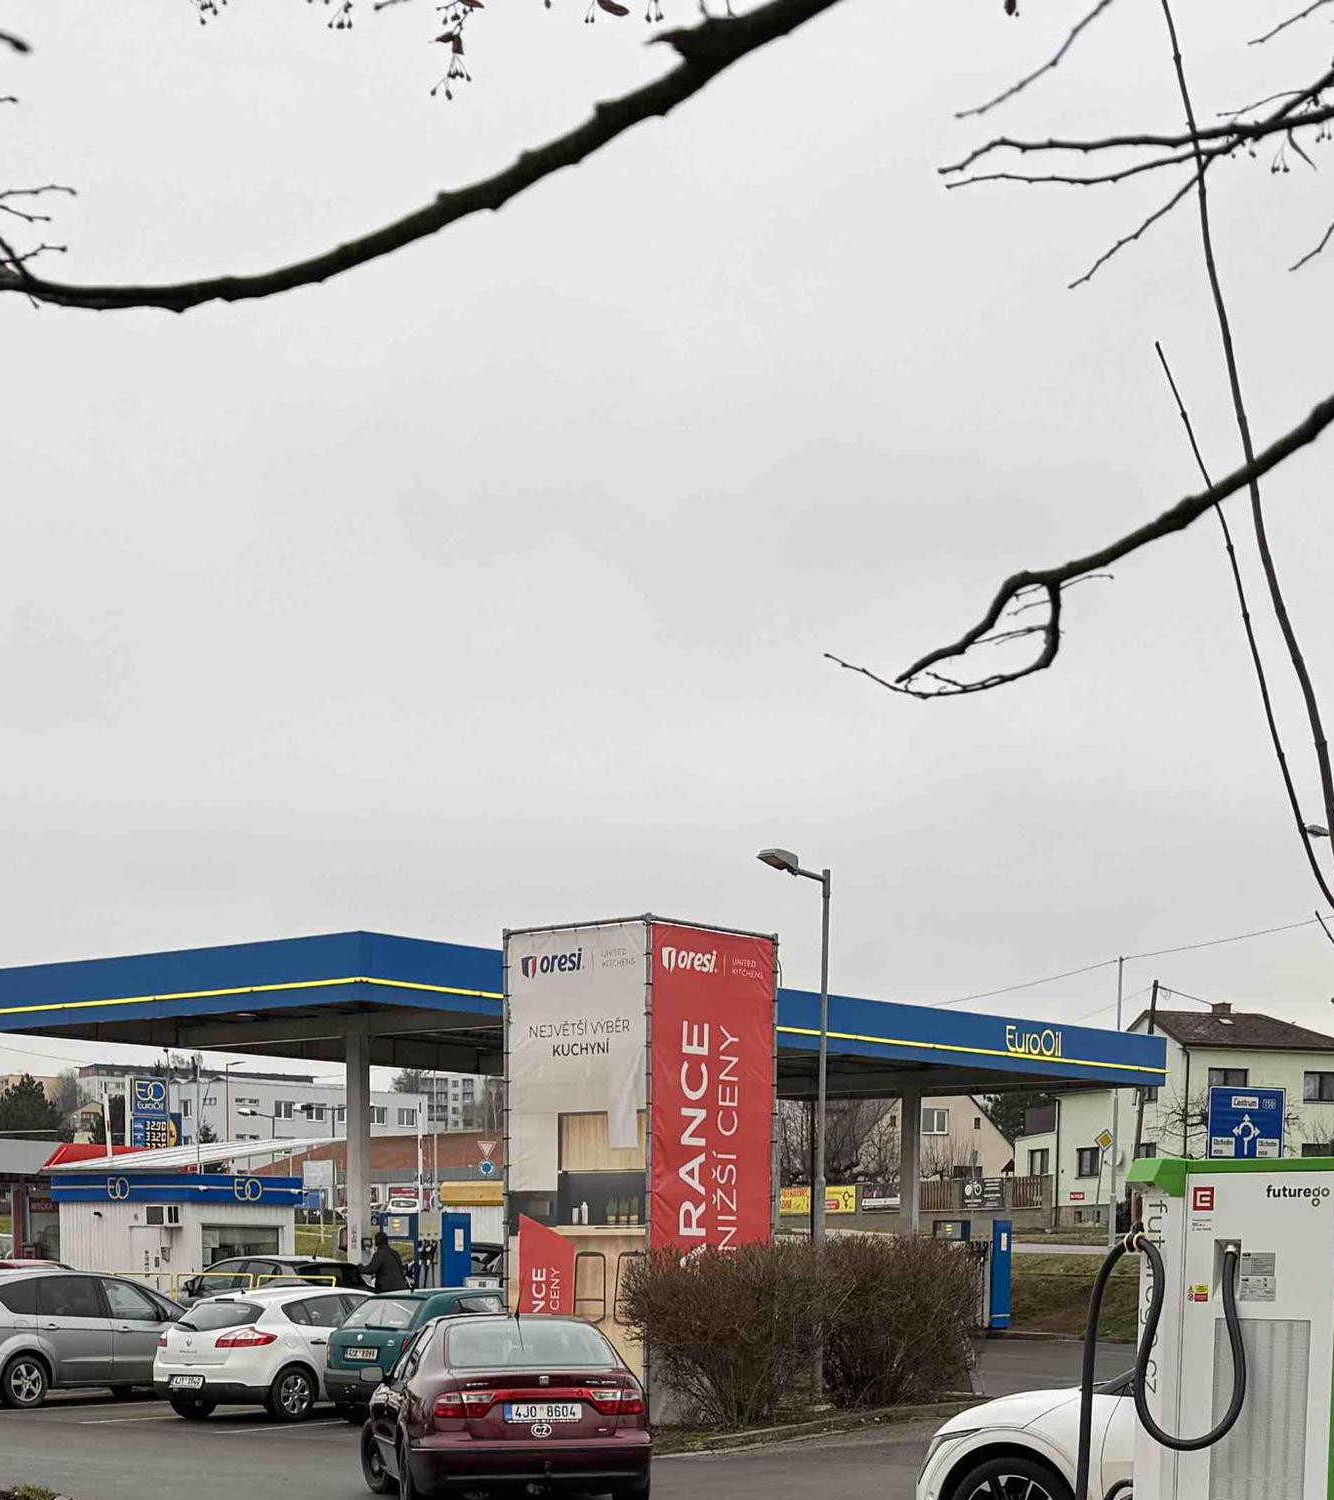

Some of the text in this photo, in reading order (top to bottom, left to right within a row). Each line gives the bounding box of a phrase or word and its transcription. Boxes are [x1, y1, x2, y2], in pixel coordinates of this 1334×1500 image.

[539, 948, 583, 973] oresi
[677, 950, 717, 974] oresi
[731, 956, 757, 968] UNITED
[528, 1018, 630, 1039] NEJVĚTŠÍ VÝBĚR
[552, 1038, 610, 1058] KUCHYNÍ
[1005, 1024, 1062, 1057] EuroOil
[1266, 1184, 1331, 1207] futurego
[549, 1267, 560, 1311] CENY
[546, 1405, 576, 1418] 8604
